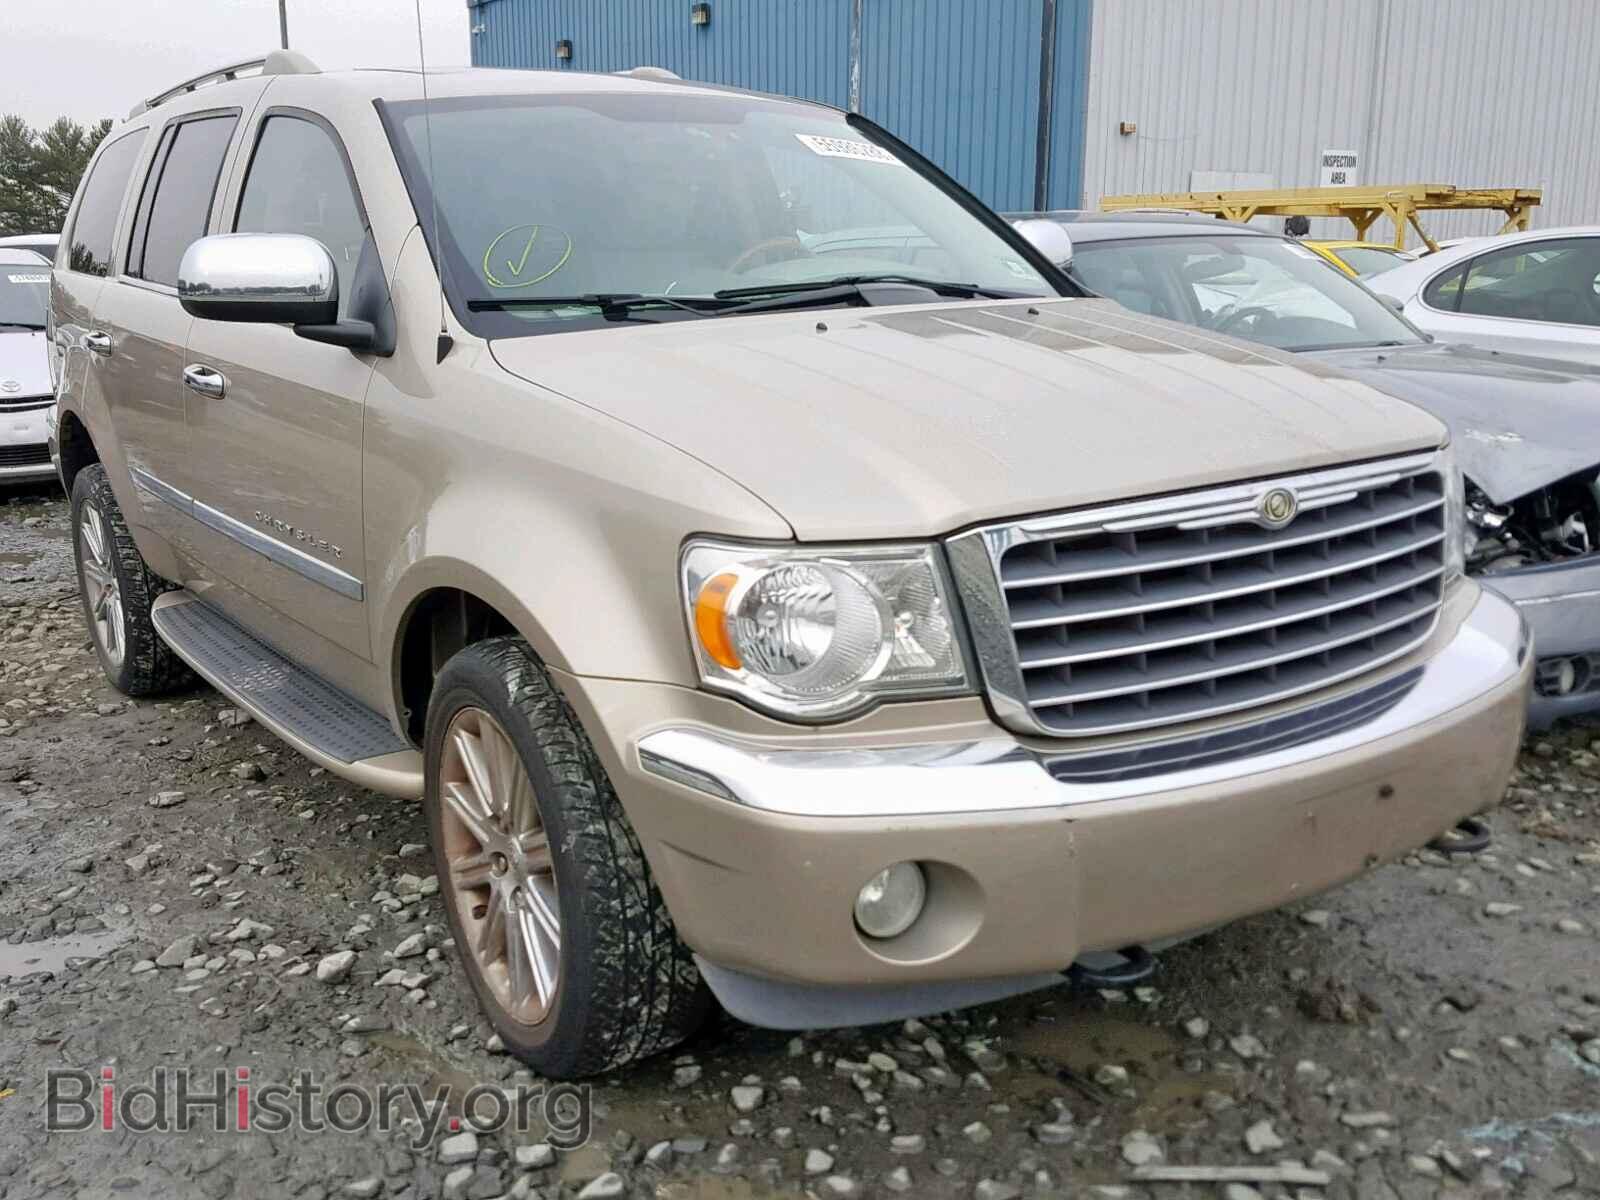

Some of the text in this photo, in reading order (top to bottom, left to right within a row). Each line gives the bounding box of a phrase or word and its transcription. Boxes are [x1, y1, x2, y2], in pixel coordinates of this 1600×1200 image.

[1322, 154, 1357, 168] INSPECTION
[1330, 171, 1346, 185] AREA
[255, 511, 344, 560] CHRYSLER
